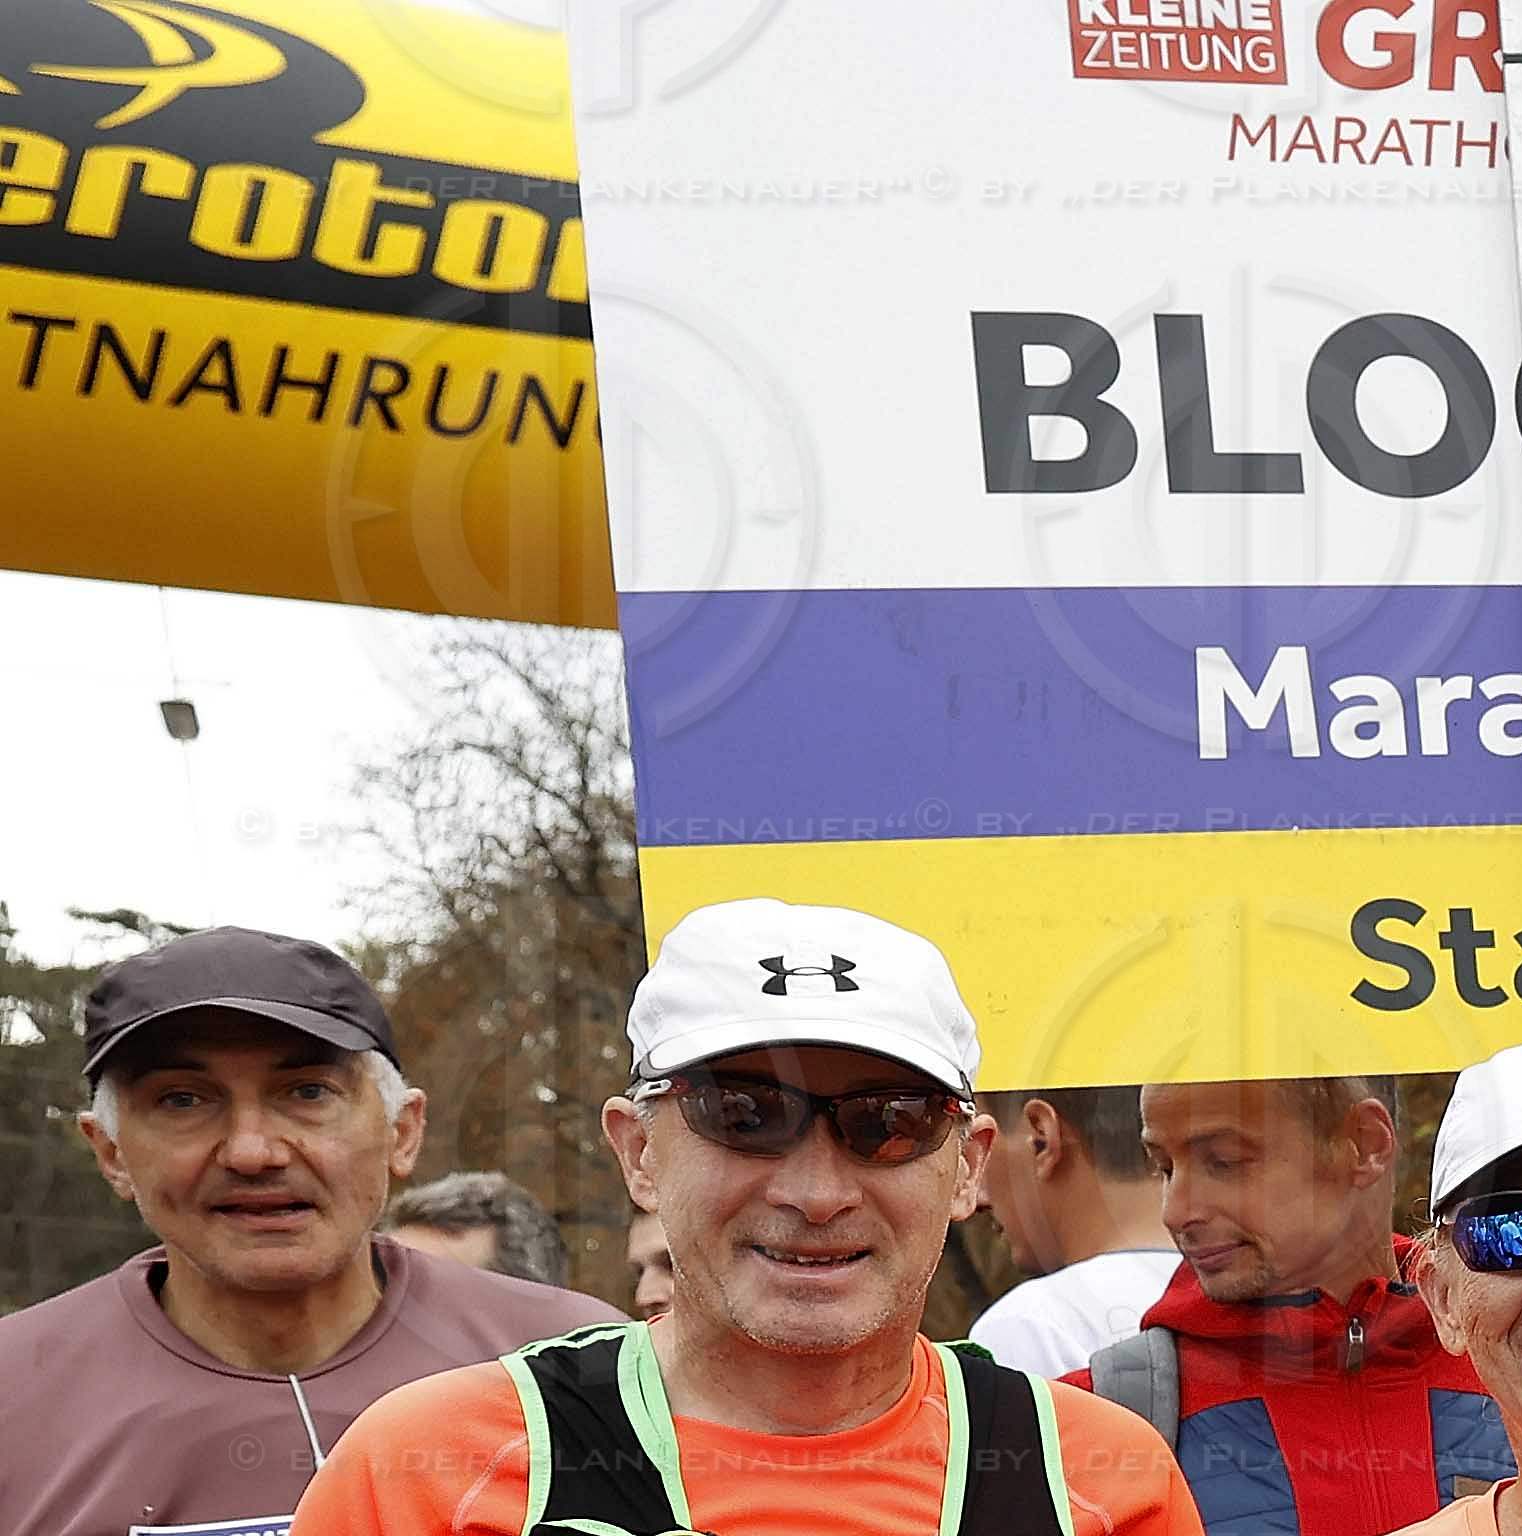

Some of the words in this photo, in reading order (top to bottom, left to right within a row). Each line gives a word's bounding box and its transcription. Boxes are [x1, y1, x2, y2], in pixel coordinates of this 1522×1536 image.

[1082, 0, 1274, 30] KLEINE
[1080, 30, 1276, 74] ZEITUNG
[6, 311, 602, 450] TNAHRUN
